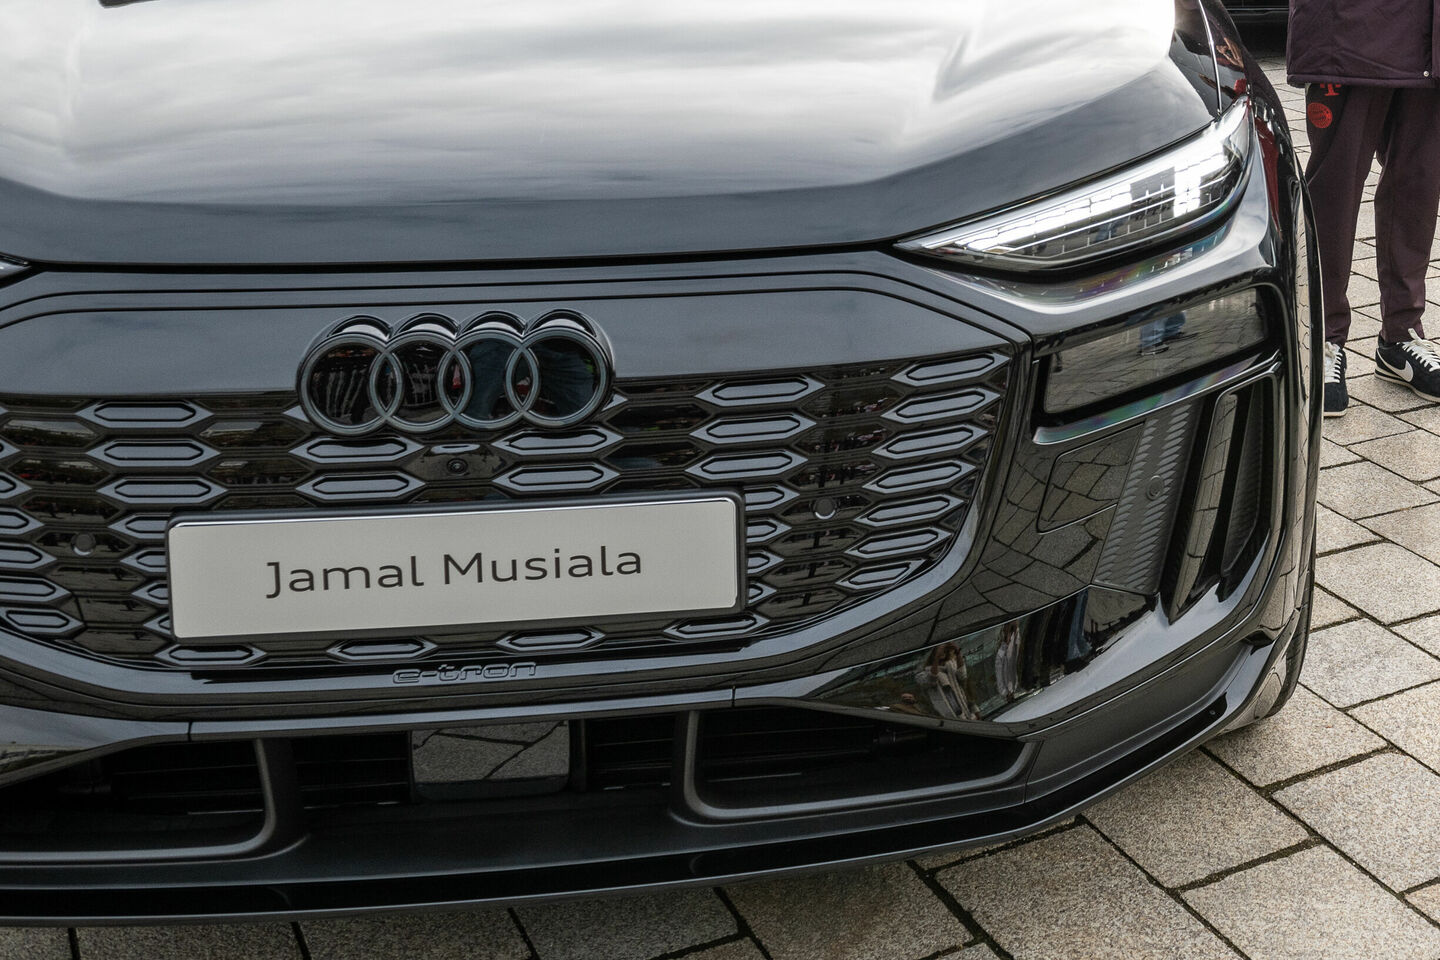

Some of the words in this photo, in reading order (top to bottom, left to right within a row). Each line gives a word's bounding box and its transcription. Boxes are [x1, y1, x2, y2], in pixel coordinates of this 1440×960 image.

[266, 556, 424, 599] Jamal
[443, 545, 642, 585] Musiala
[392, 661, 537, 685] e-tron
